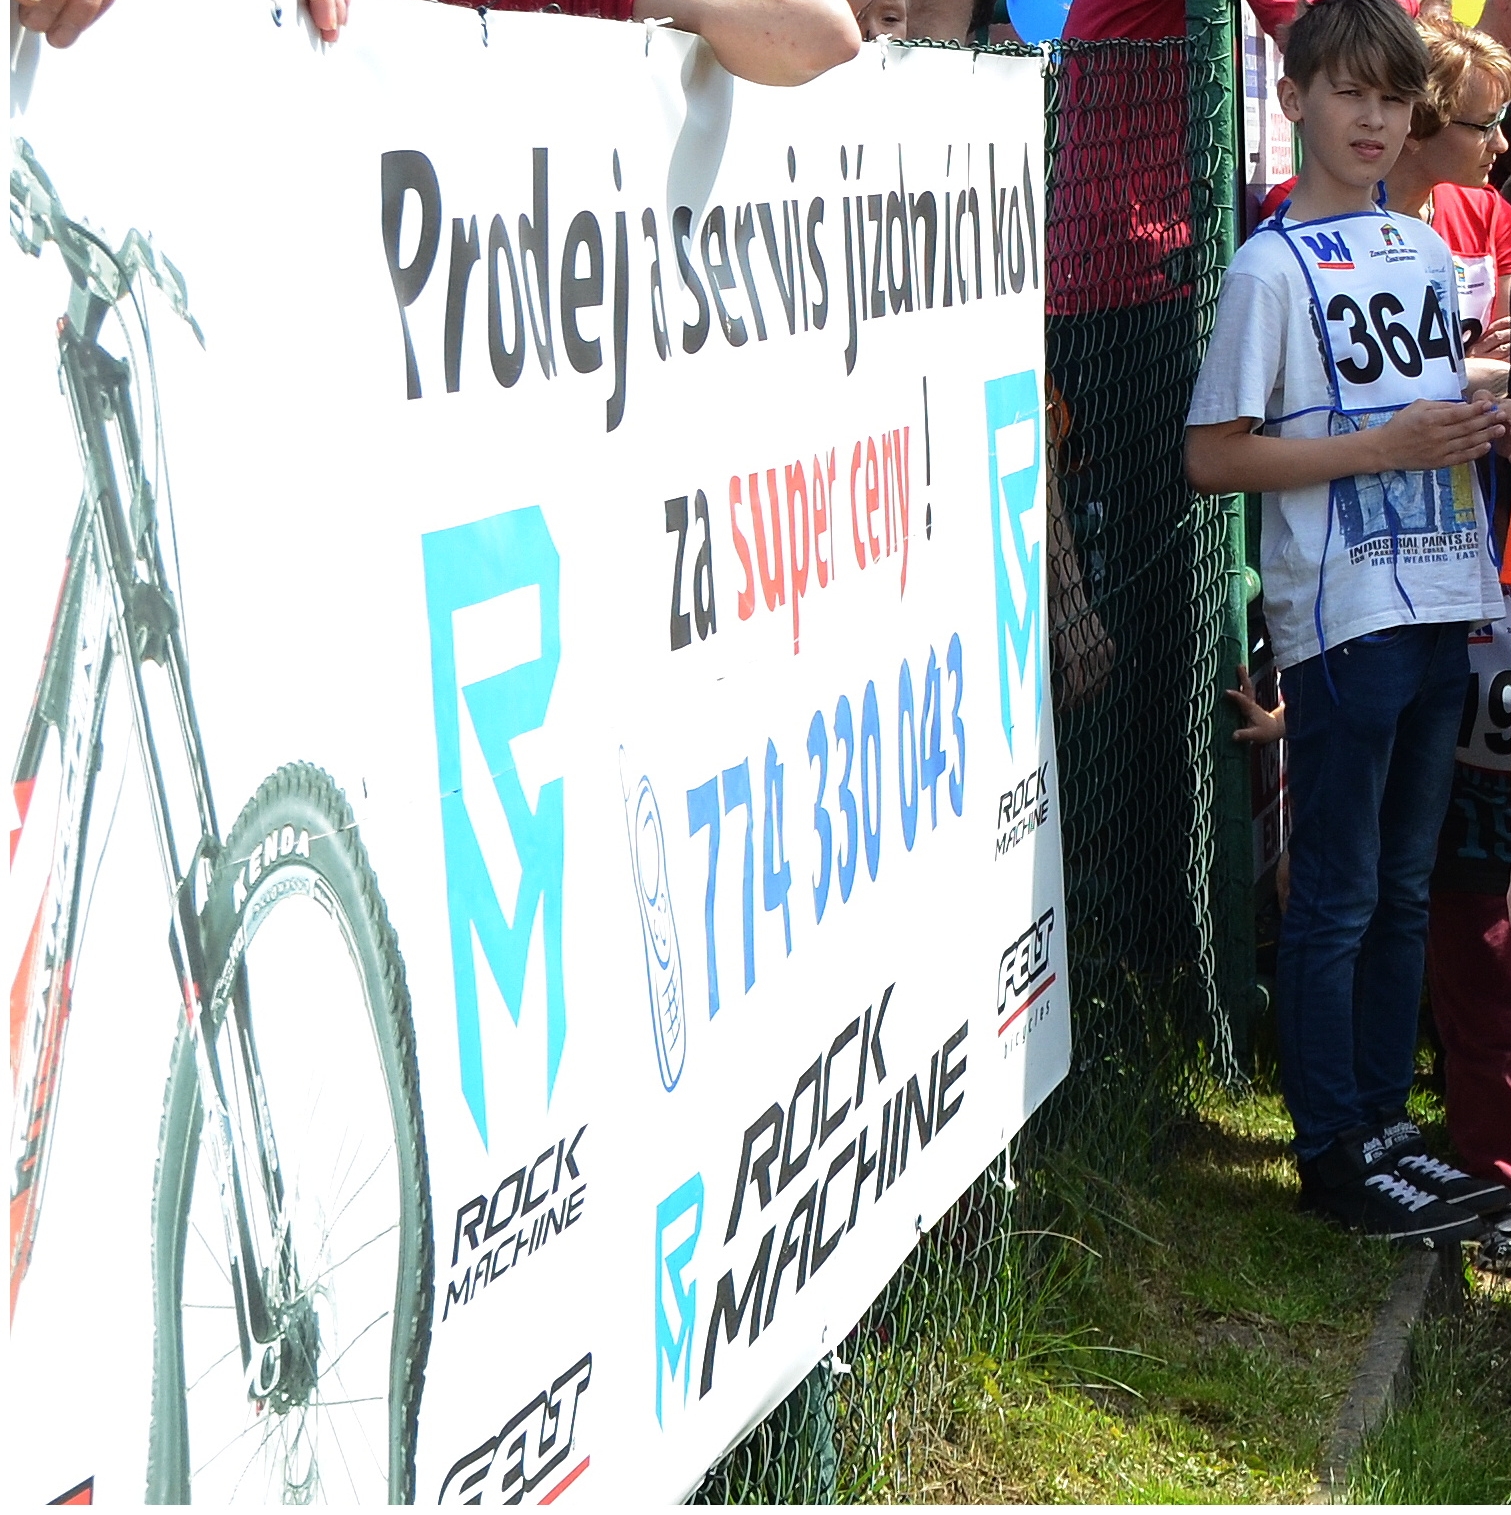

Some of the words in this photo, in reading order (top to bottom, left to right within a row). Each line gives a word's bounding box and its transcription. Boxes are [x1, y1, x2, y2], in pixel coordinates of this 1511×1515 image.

[381, 147, 630, 434] Prodej
[642, 206, 672, 362] a
[675, 146, 828, 355] servis
[841, 143, 983, 377] jízdních
[1326, 285, 1457, 384] 364
[663, 488, 717, 652] za
[728, 446, 837, 656] super
[850, 425, 910, 603] ceny
[922, 375, 933, 541] !
[232, 822, 311, 915] KENDA
[686, 736, 792, 1023] 774
[807, 679, 883, 926] 330
[898, 631, 967, 853] 043
[994, 797, 1050, 863] MACHINE
[997, 760, 1050, 831] ROCK
[722, 982, 897, 1248] ROCK
[442, 1181, 588, 1323] MACHINE
[451, 1122, 590, 1268] ROCK
[698, 1018, 970, 1402] MACHINE
